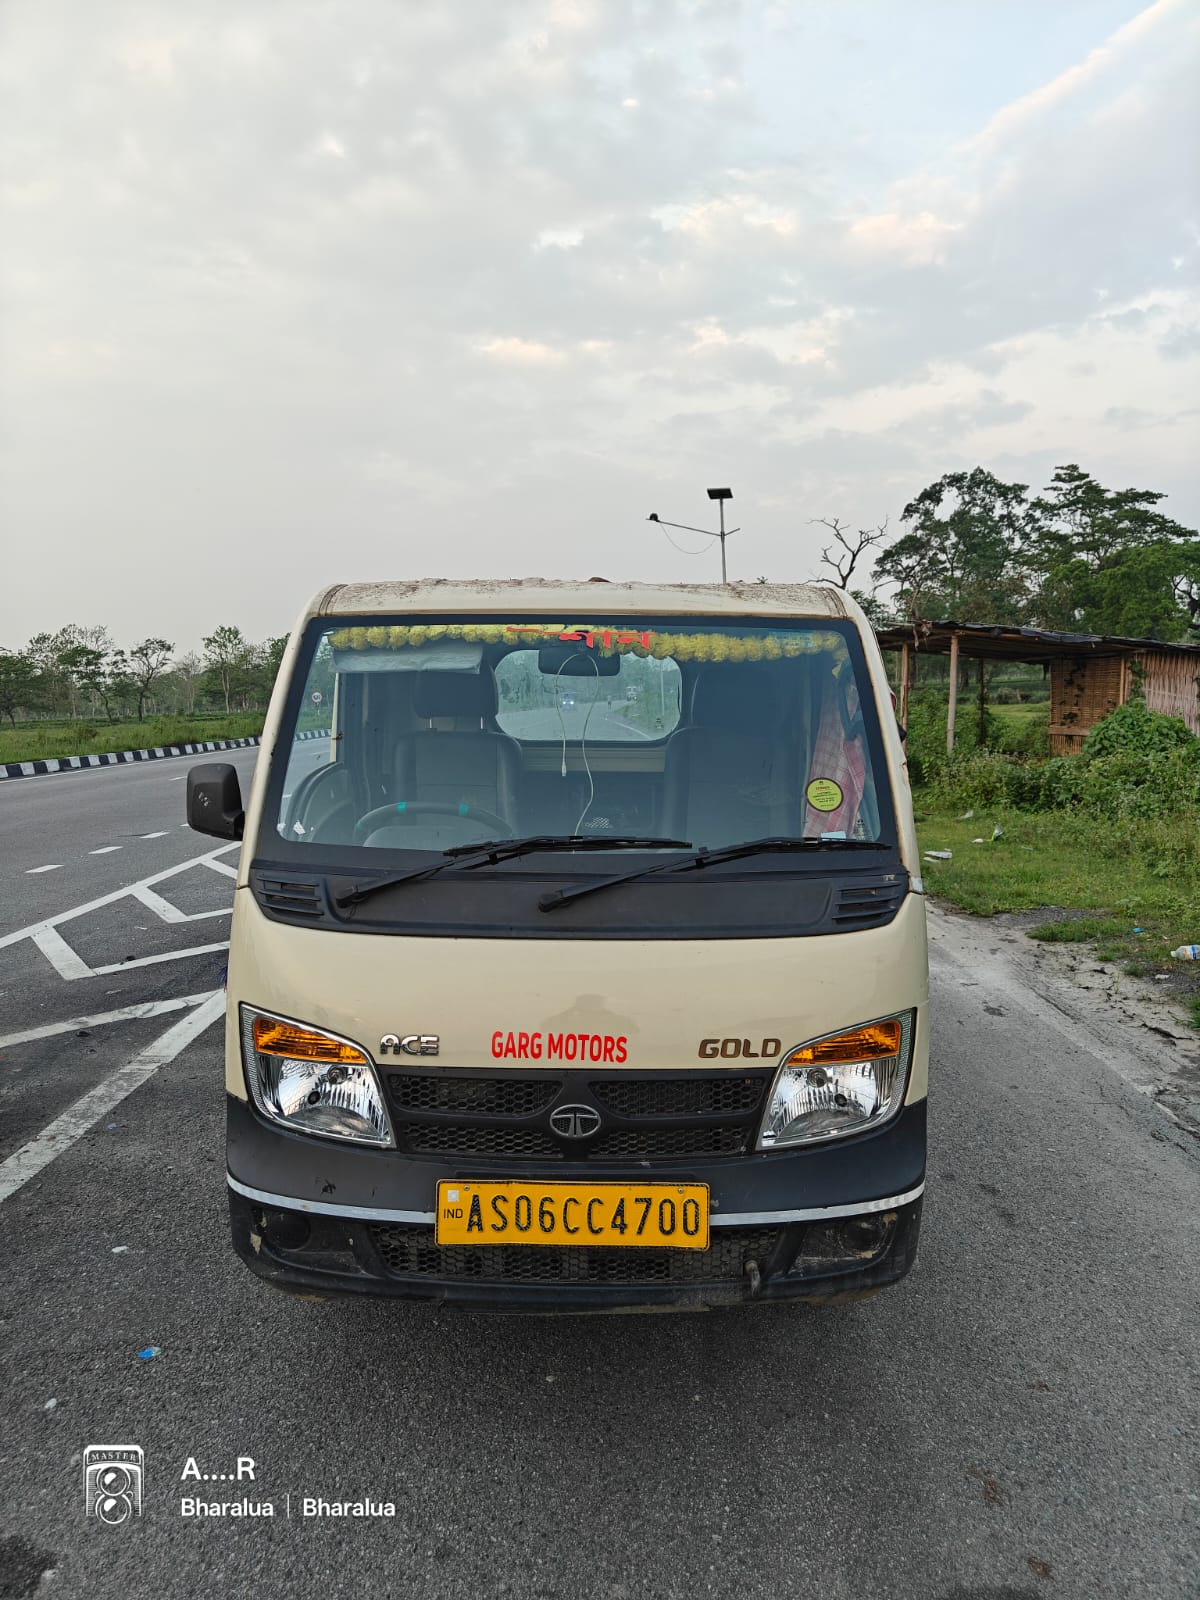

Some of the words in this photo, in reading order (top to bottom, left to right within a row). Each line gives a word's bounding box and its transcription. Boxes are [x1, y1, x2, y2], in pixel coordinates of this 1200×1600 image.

[380, 1034, 440, 1056] ACE
[491, 1031, 543, 1060] GARG
[547, 1033, 629, 1063] MOTORS
[698, 1038, 782, 1058] GOLD
[443, 1208, 464, 1219] IND
[466, 1194, 701, 1235] AS06CC4700
